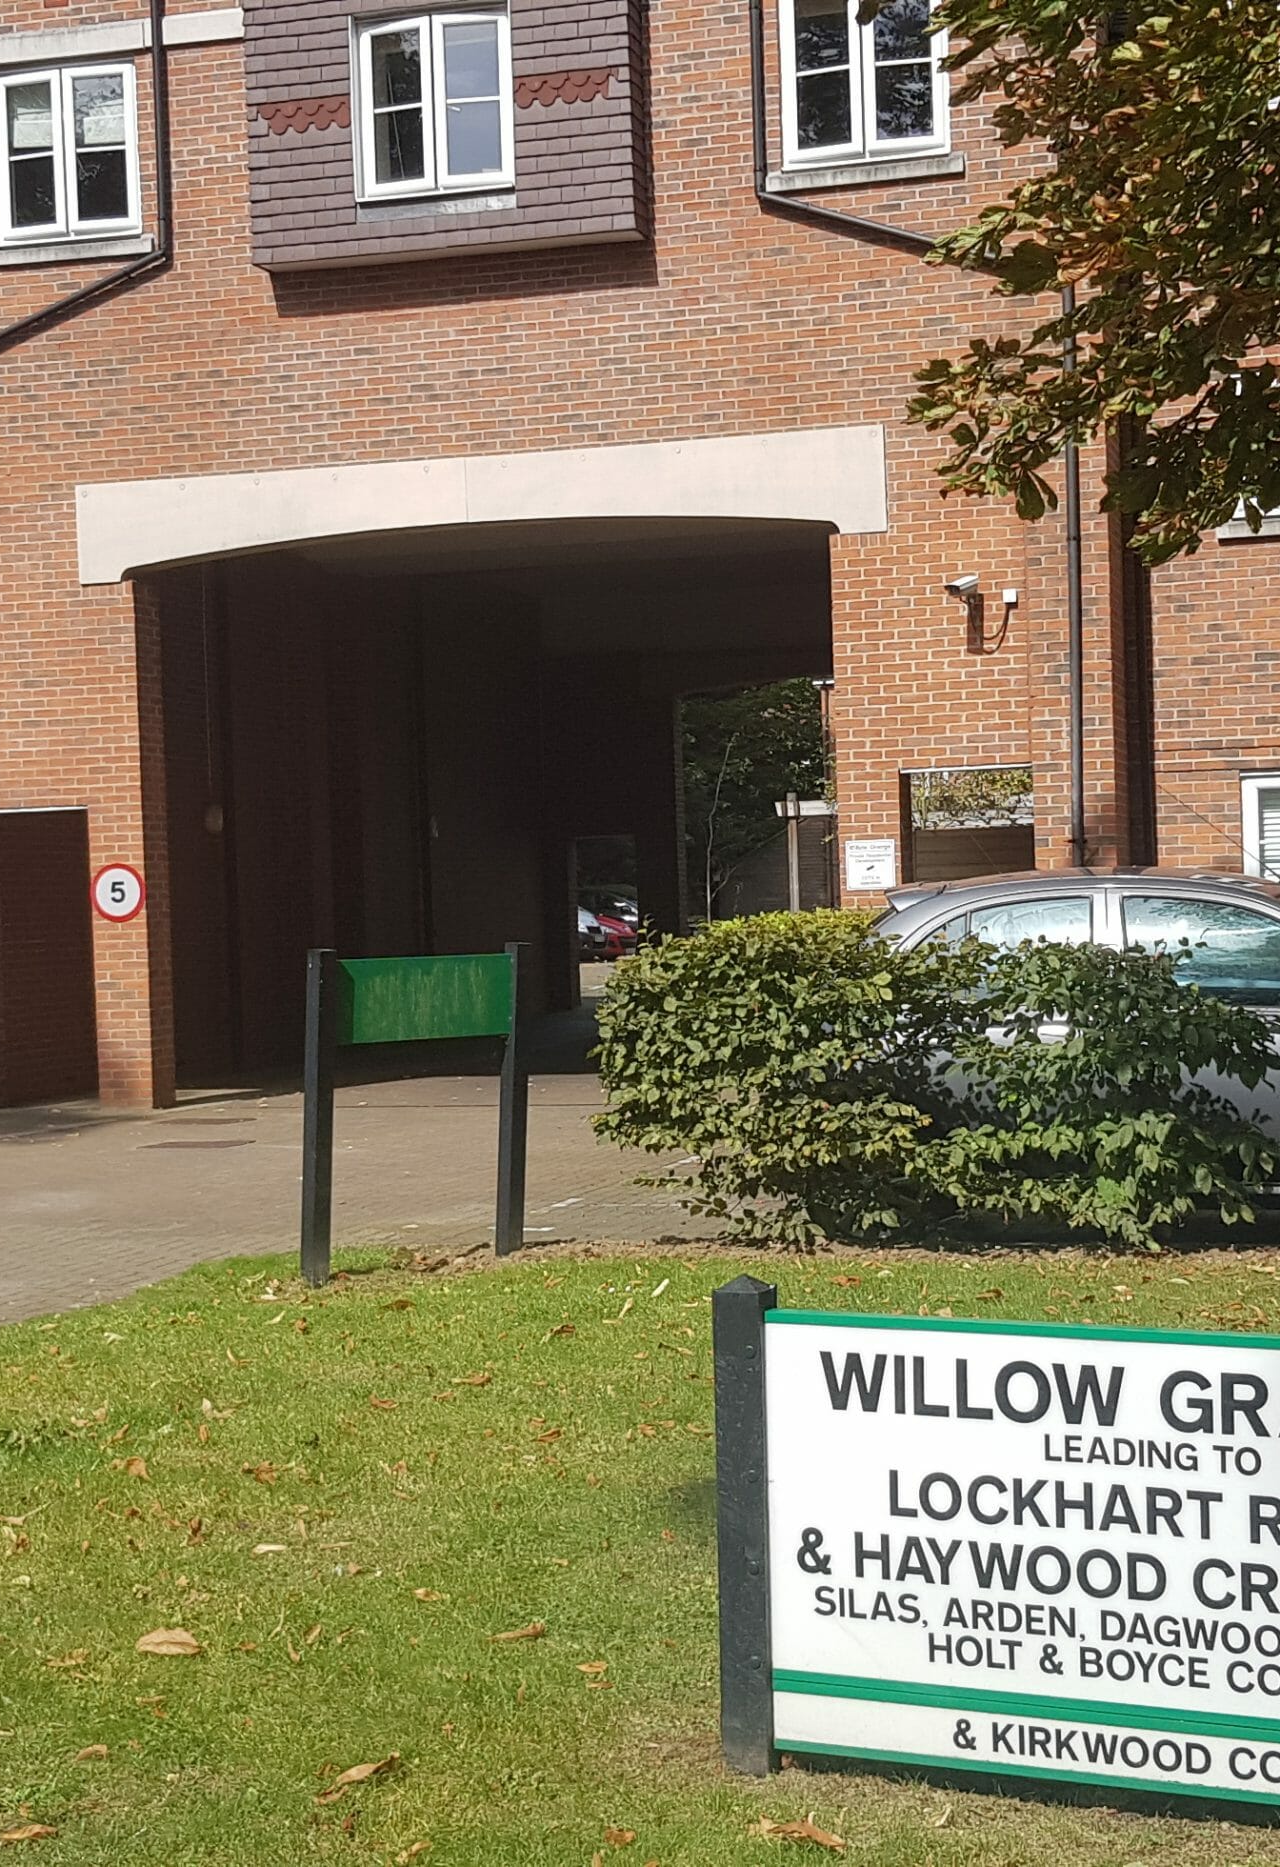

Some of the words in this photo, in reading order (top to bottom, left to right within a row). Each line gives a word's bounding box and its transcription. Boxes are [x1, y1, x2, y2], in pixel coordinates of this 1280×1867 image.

[110, 881, 126, 903] 5
[819, 1351, 1125, 1427] WILLOW
[1044, 1434, 1198, 1472] LEADING
[1212, 1445, 1262, 1476] TO
[889, 1469, 1223, 1540] LOCKHART
[797, 1527, 832, 1575] &
[854, 1531, 1167, 1602] HAYWOOD
[814, 1585, 929, 1629] SILAS,
[943, 1597, 1087, 1643] ARDEN,
[928, 1632, 1023, 1670] HOLT
[1039, 1643, 1064, 1675] &
[1079, 1646, 1210, 1689] BOYCE
[953, 1718, 977, 1751] &
[992, 1722, 1212, 1775] KIRKWOOD
